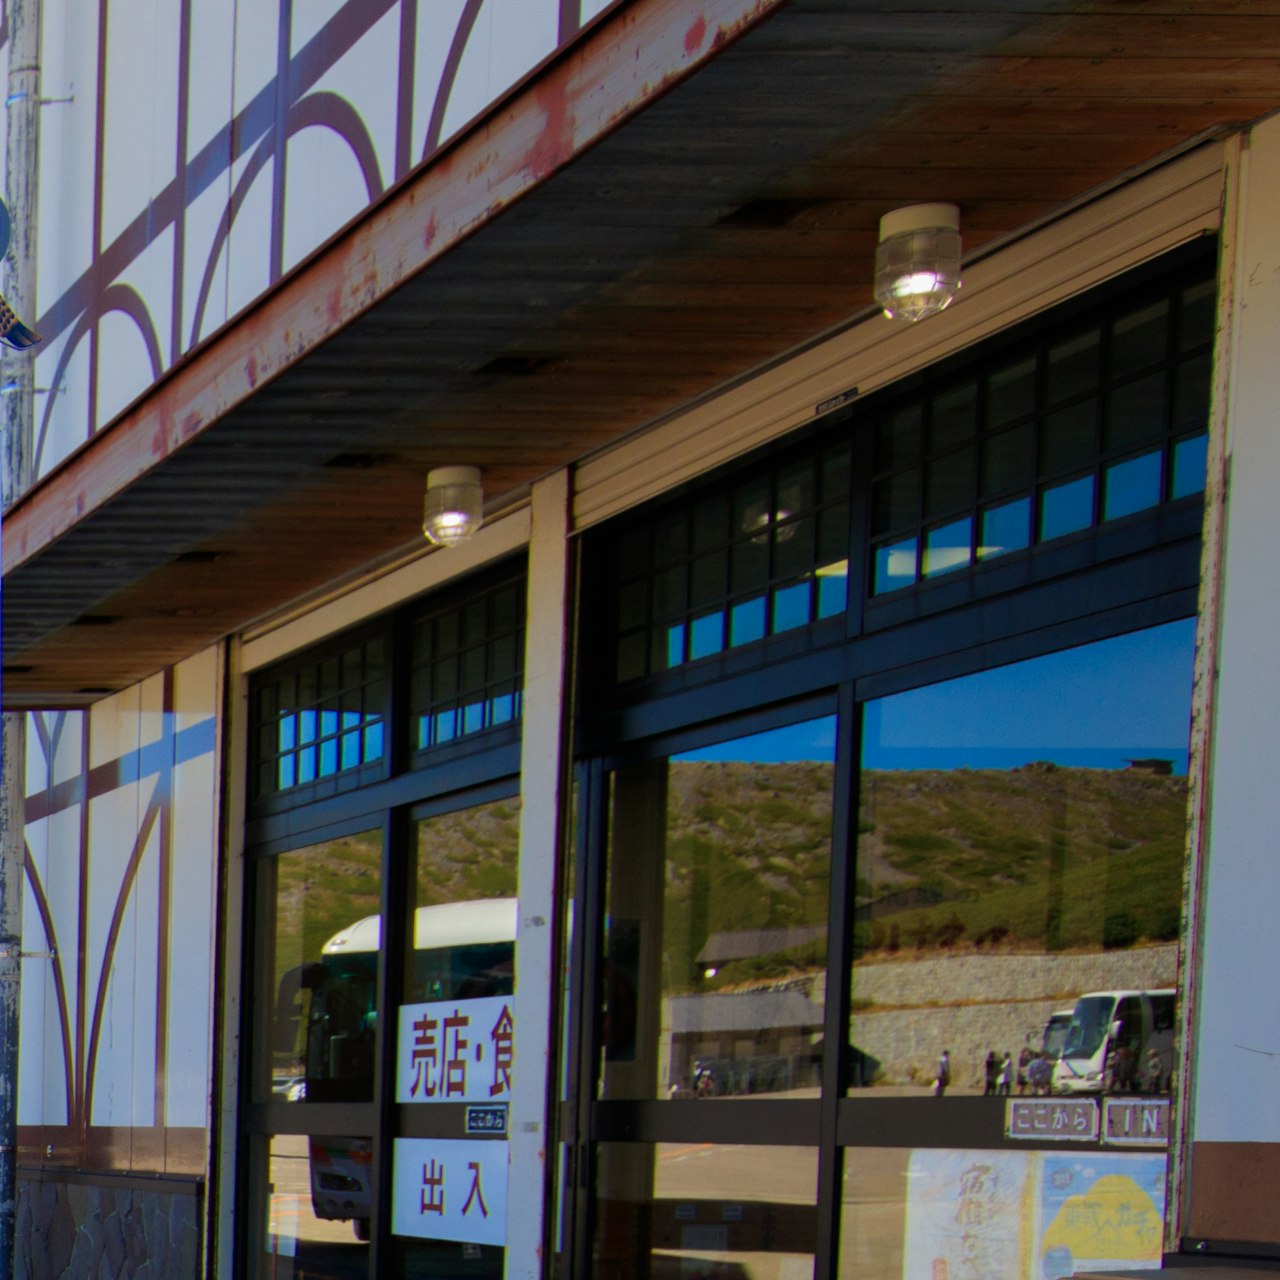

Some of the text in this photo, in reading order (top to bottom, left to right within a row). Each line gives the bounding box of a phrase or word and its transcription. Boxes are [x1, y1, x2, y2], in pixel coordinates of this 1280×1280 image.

[470, 1112, 503, 1128] ここから
[1017, 1107, 1087, 1130] ここから
[1125, 1109, 1158, 1132] IN
